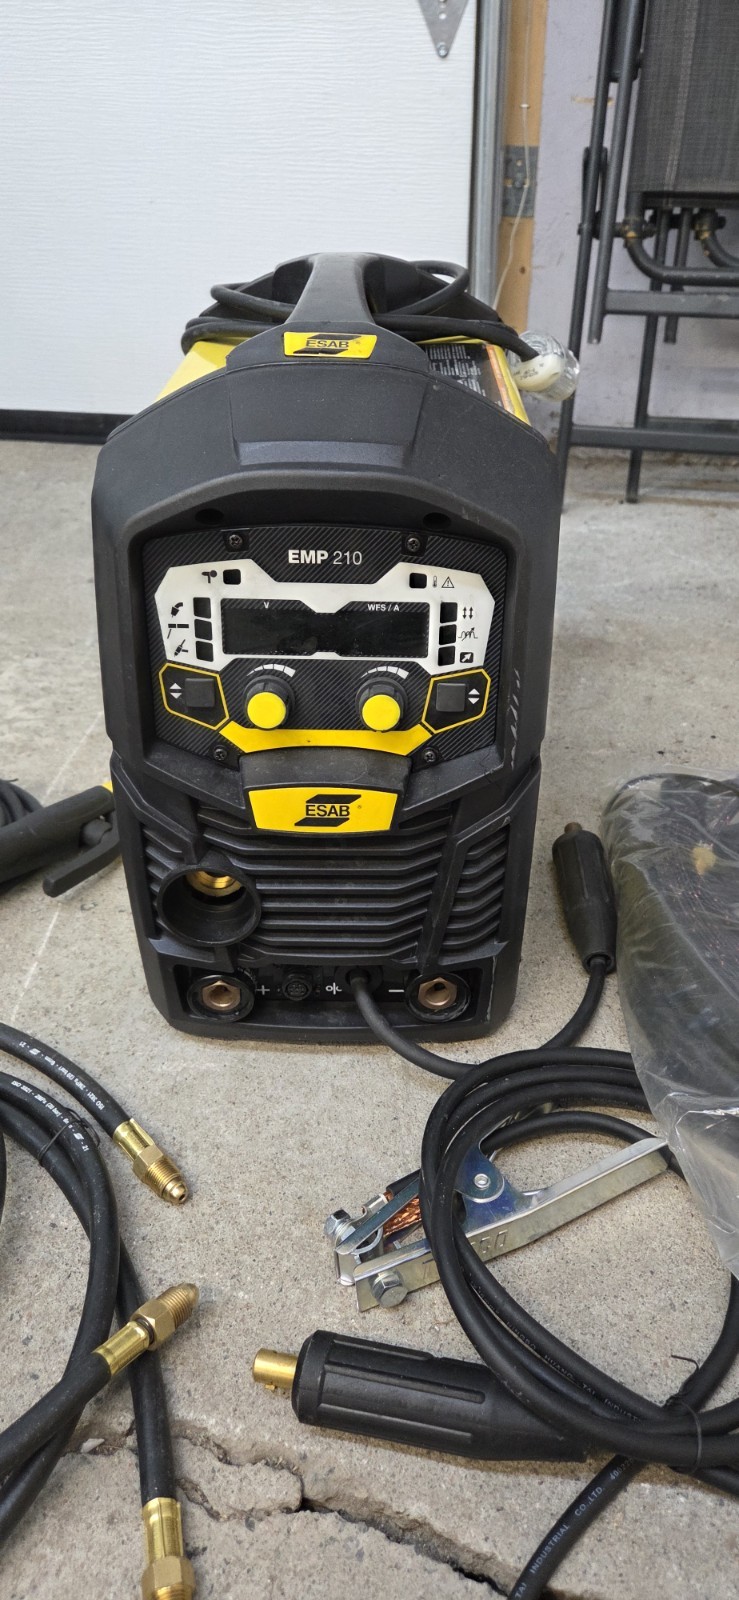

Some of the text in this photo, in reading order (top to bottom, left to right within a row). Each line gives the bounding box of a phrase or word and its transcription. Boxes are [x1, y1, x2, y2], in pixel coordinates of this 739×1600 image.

[306, 340, 349, 348] ESAB
[288, 549, 362, 565] EMP 210
[368, 604, 386, 612] WFS
[393, 604, 400, 612] A
[306, 805, 350, 816] ESAB
[529, 1523, 570, 1575] INDUSTRIAL
